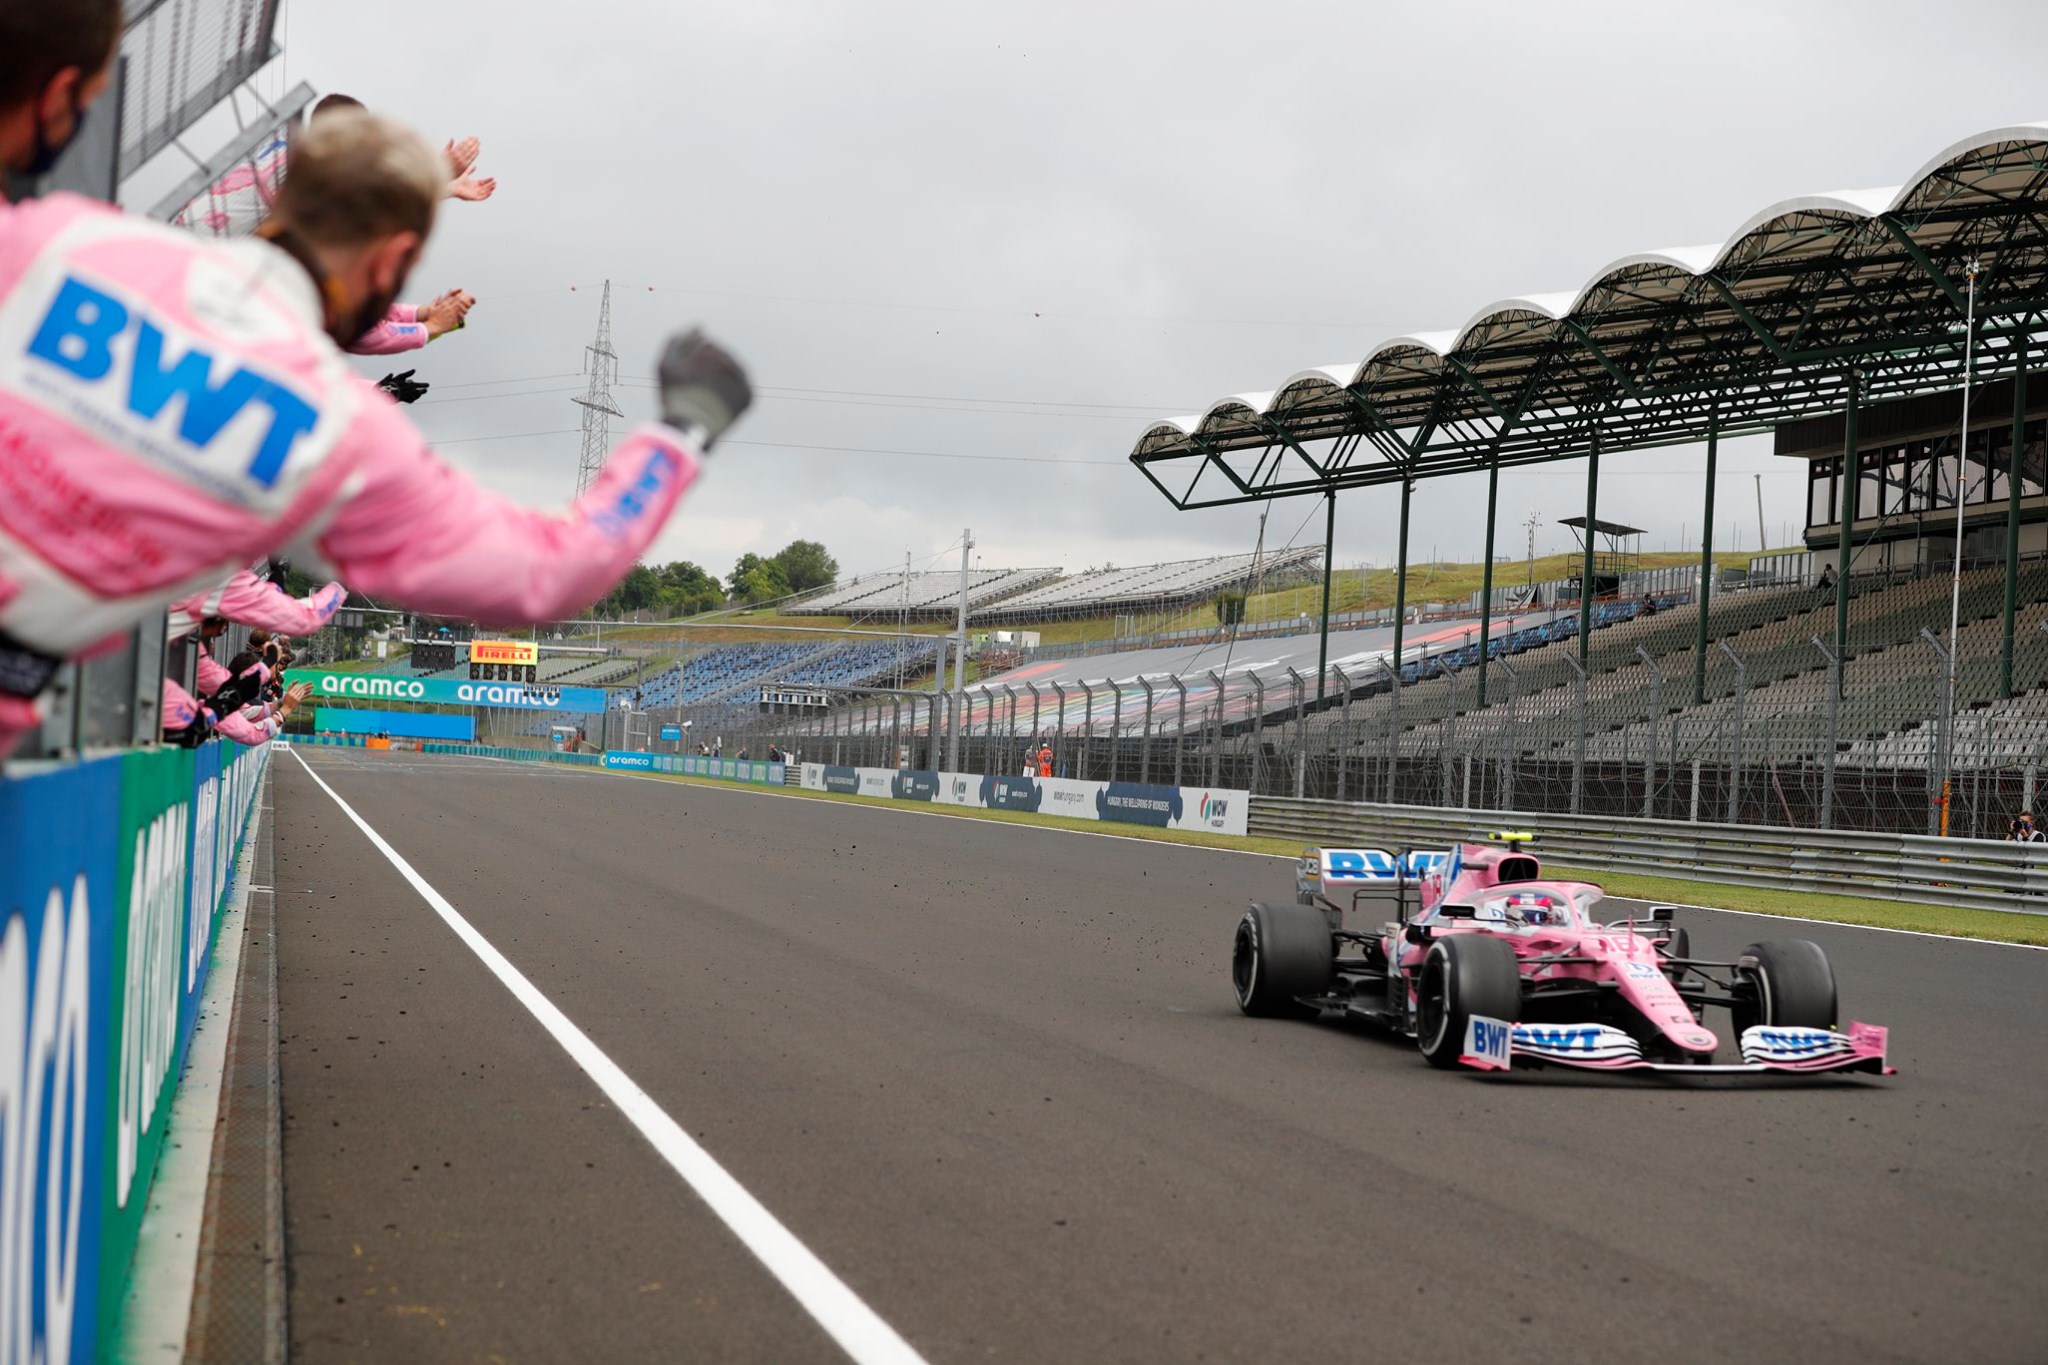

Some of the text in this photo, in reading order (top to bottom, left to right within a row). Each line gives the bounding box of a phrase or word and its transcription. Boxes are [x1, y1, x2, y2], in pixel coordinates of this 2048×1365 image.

[26, 275, 319, 492] BWT
[477, 645, 532, 660] PIRELLI
[322, 675, 424, 698] aramco
[457, 684, 560, 706] aramco
[609, 756, 650, 766] aramco
[1211, 800, 1229, 817] WOW
[1473, 1020, 1508, 1060] BWT
[1512, 1028, 1601, 1053] BWT
